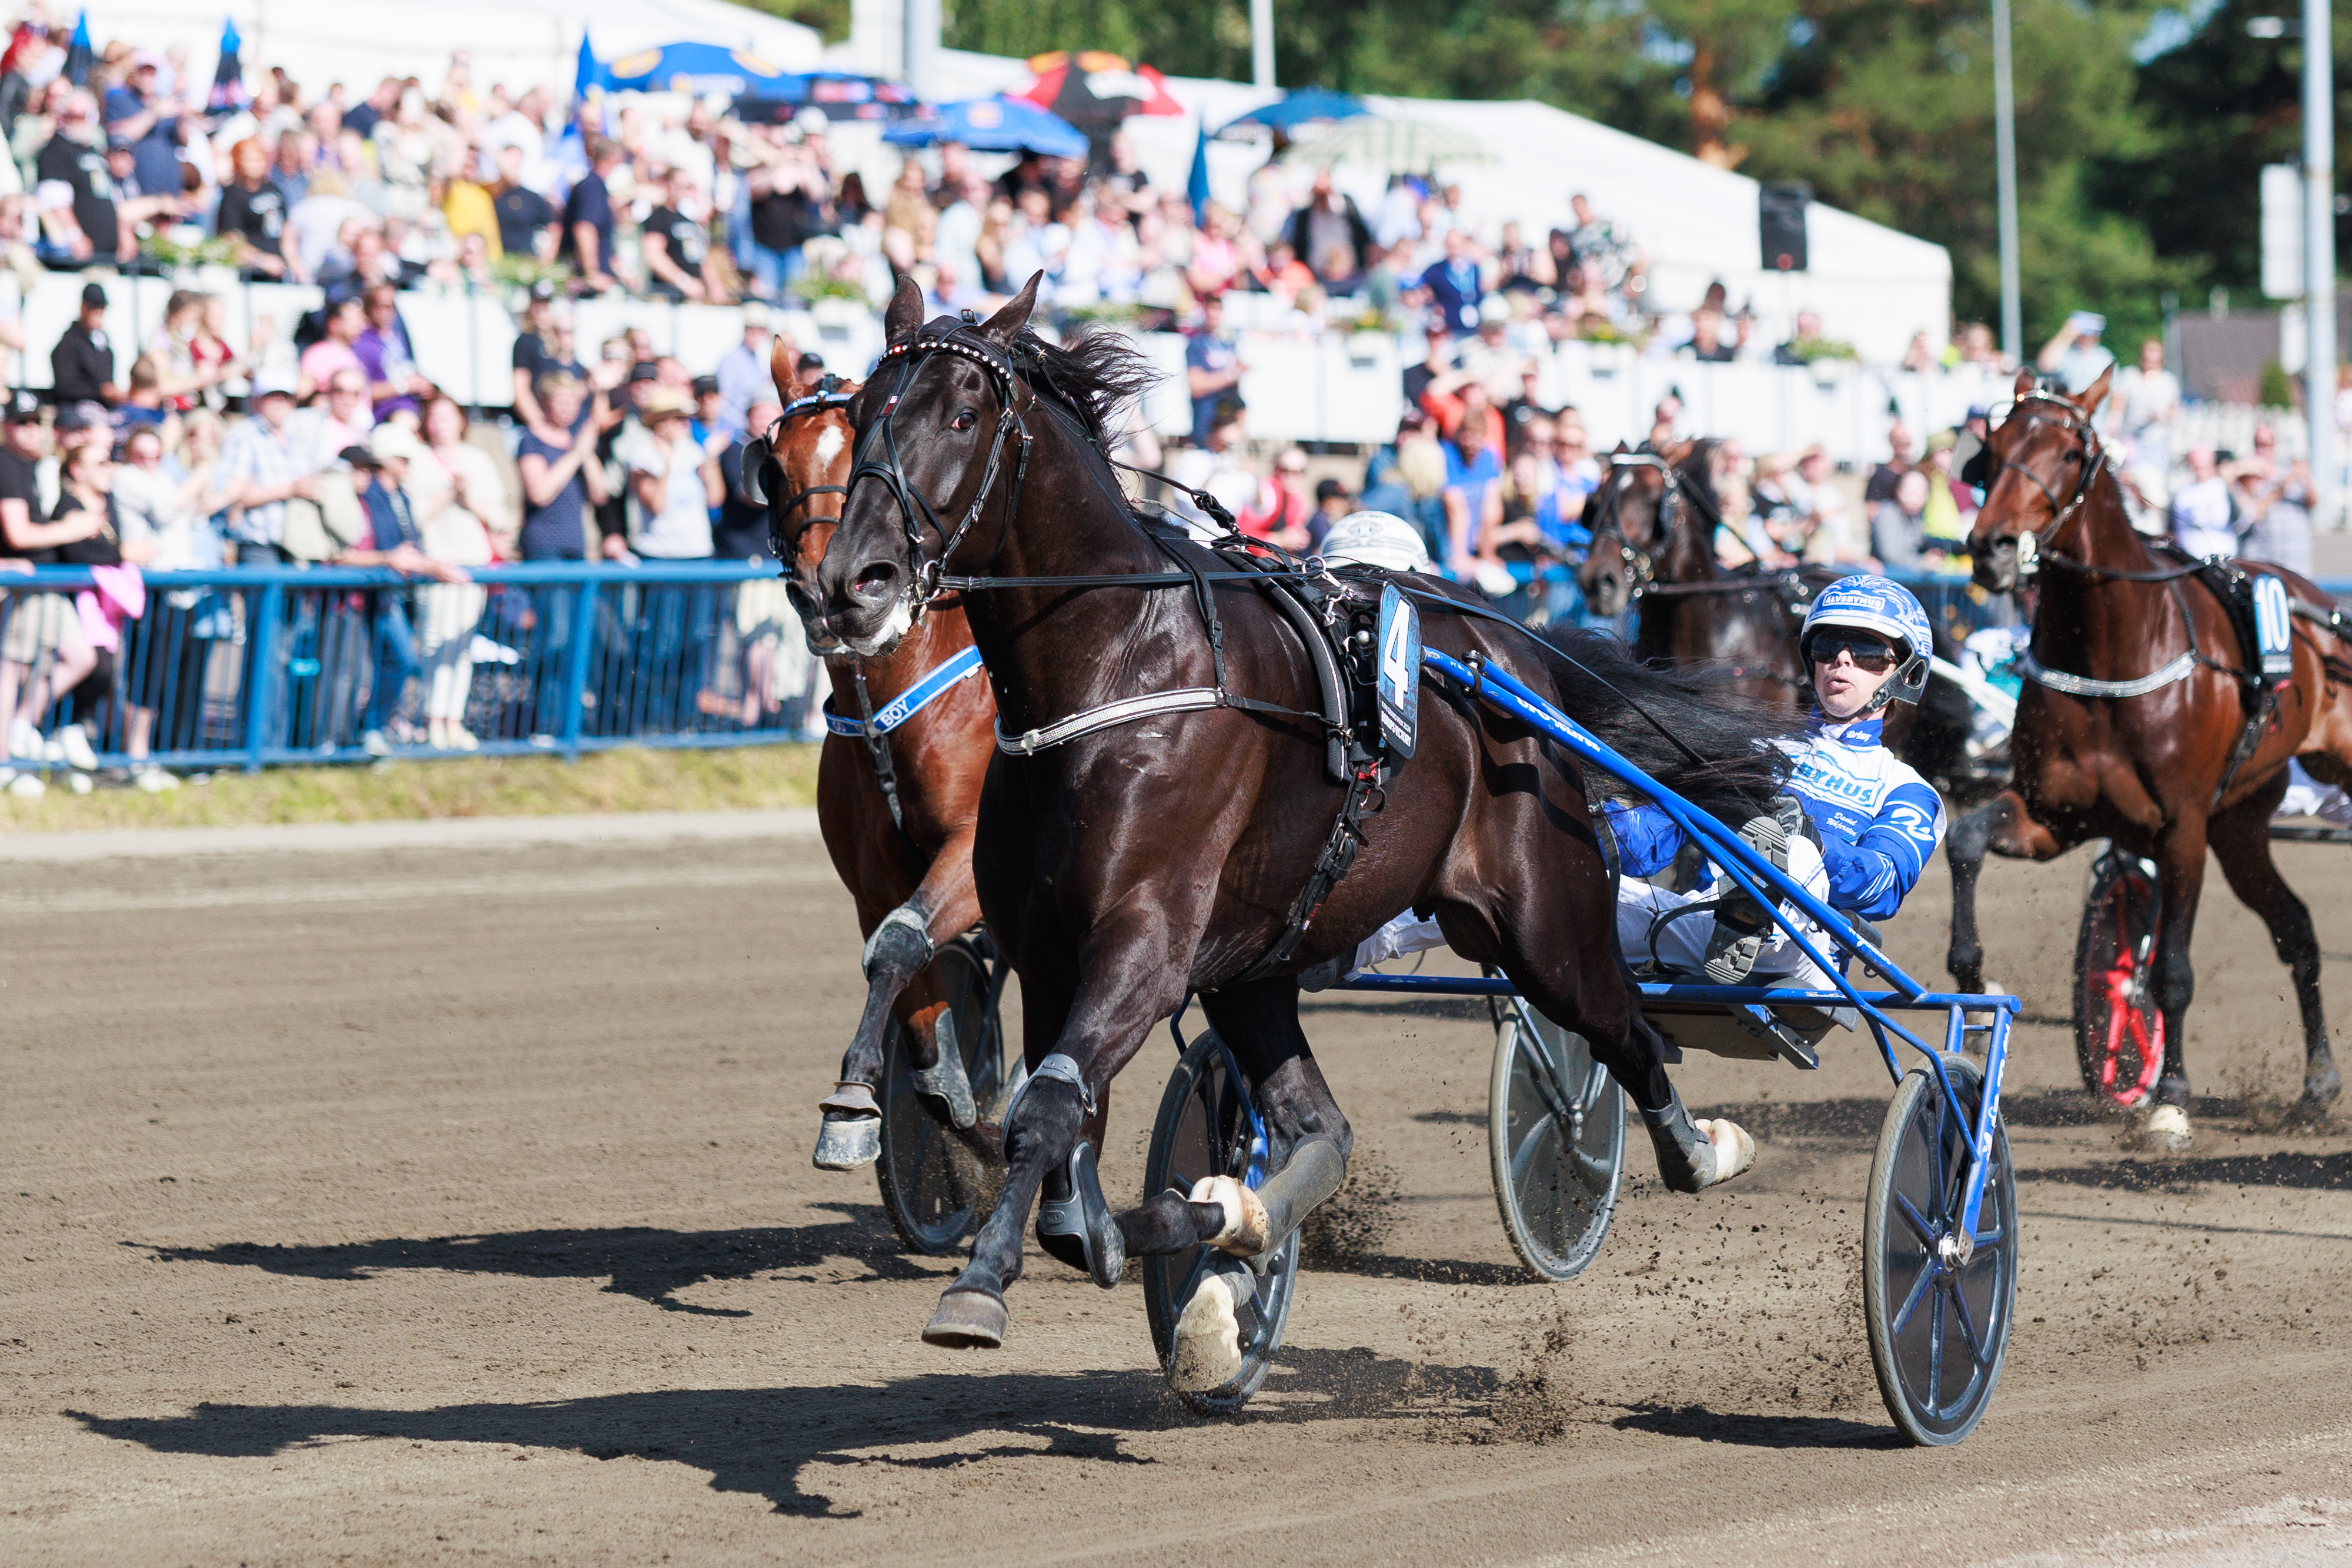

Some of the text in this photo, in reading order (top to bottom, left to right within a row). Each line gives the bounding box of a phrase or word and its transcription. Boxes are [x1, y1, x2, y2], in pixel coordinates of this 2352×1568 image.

[2254, 577, 2291, 652] 10
[1384, 599, 1411, 711] 4
[880, 698, 909, 728] BOY
[1395, 724, 1412, 747] VICTORY
[1796, 762, 1873, 802] BYHUS
